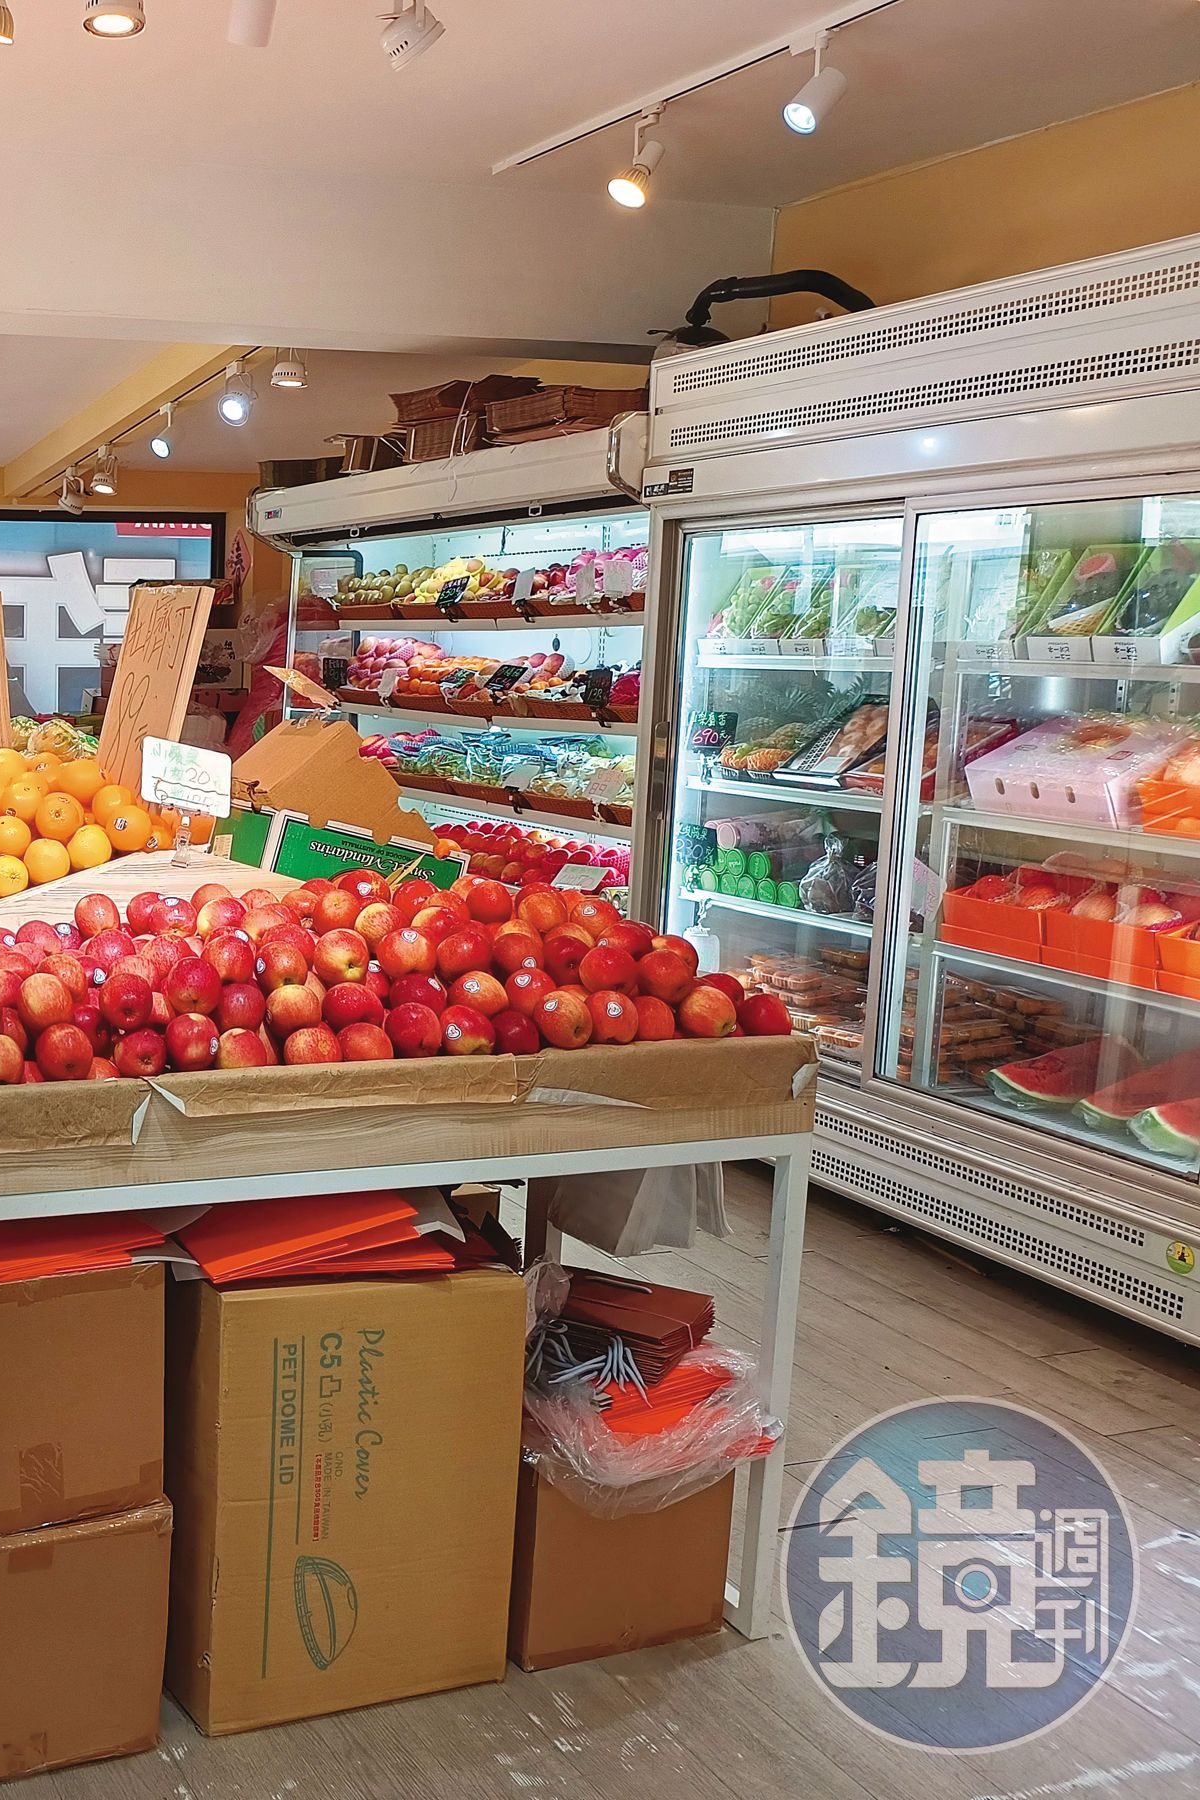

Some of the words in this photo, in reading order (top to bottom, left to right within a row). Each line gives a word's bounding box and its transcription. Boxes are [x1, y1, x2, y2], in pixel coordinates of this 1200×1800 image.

[308, 840, 392, 870] Mandarins
[281, 1343, 298, 1386] PET
[319, 1332, 343, 1370] C5
[355, 1328, 386, 1425] Plastic
[280, 1388, 298, 1449] DOME
[278, 1455, 296, 1486] LID
[323, 1452, 333, 1482] MADE
[353, 1429, 384, 1501] Cover
[322, 1487, 332, 1498] IN
[321, 1502, 332, 1541] TAIWAN
